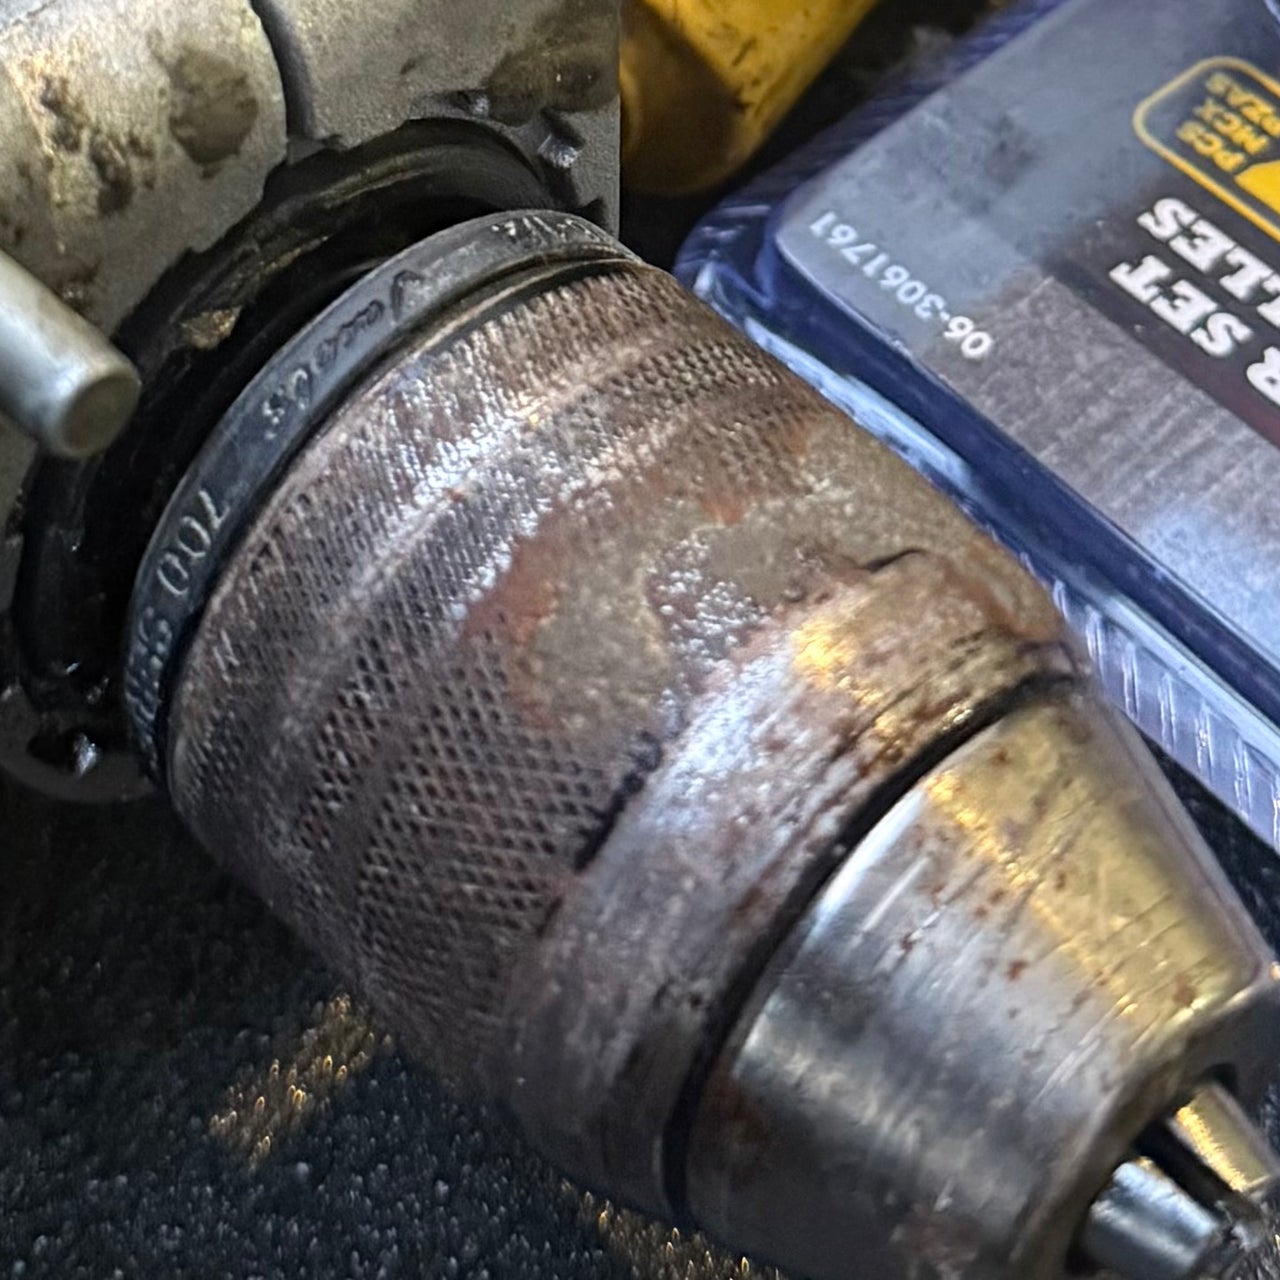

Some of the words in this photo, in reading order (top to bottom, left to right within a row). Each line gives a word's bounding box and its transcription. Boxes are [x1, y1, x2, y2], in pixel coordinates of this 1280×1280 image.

[1175, 119, 1246, 173] PCS
[1192, 96, 1270, 155] MCX
[809, 210, 993, 361] 06-3061761
[1110, 251, 1254, 361] SET
[155, 488, 231, 598] 700
